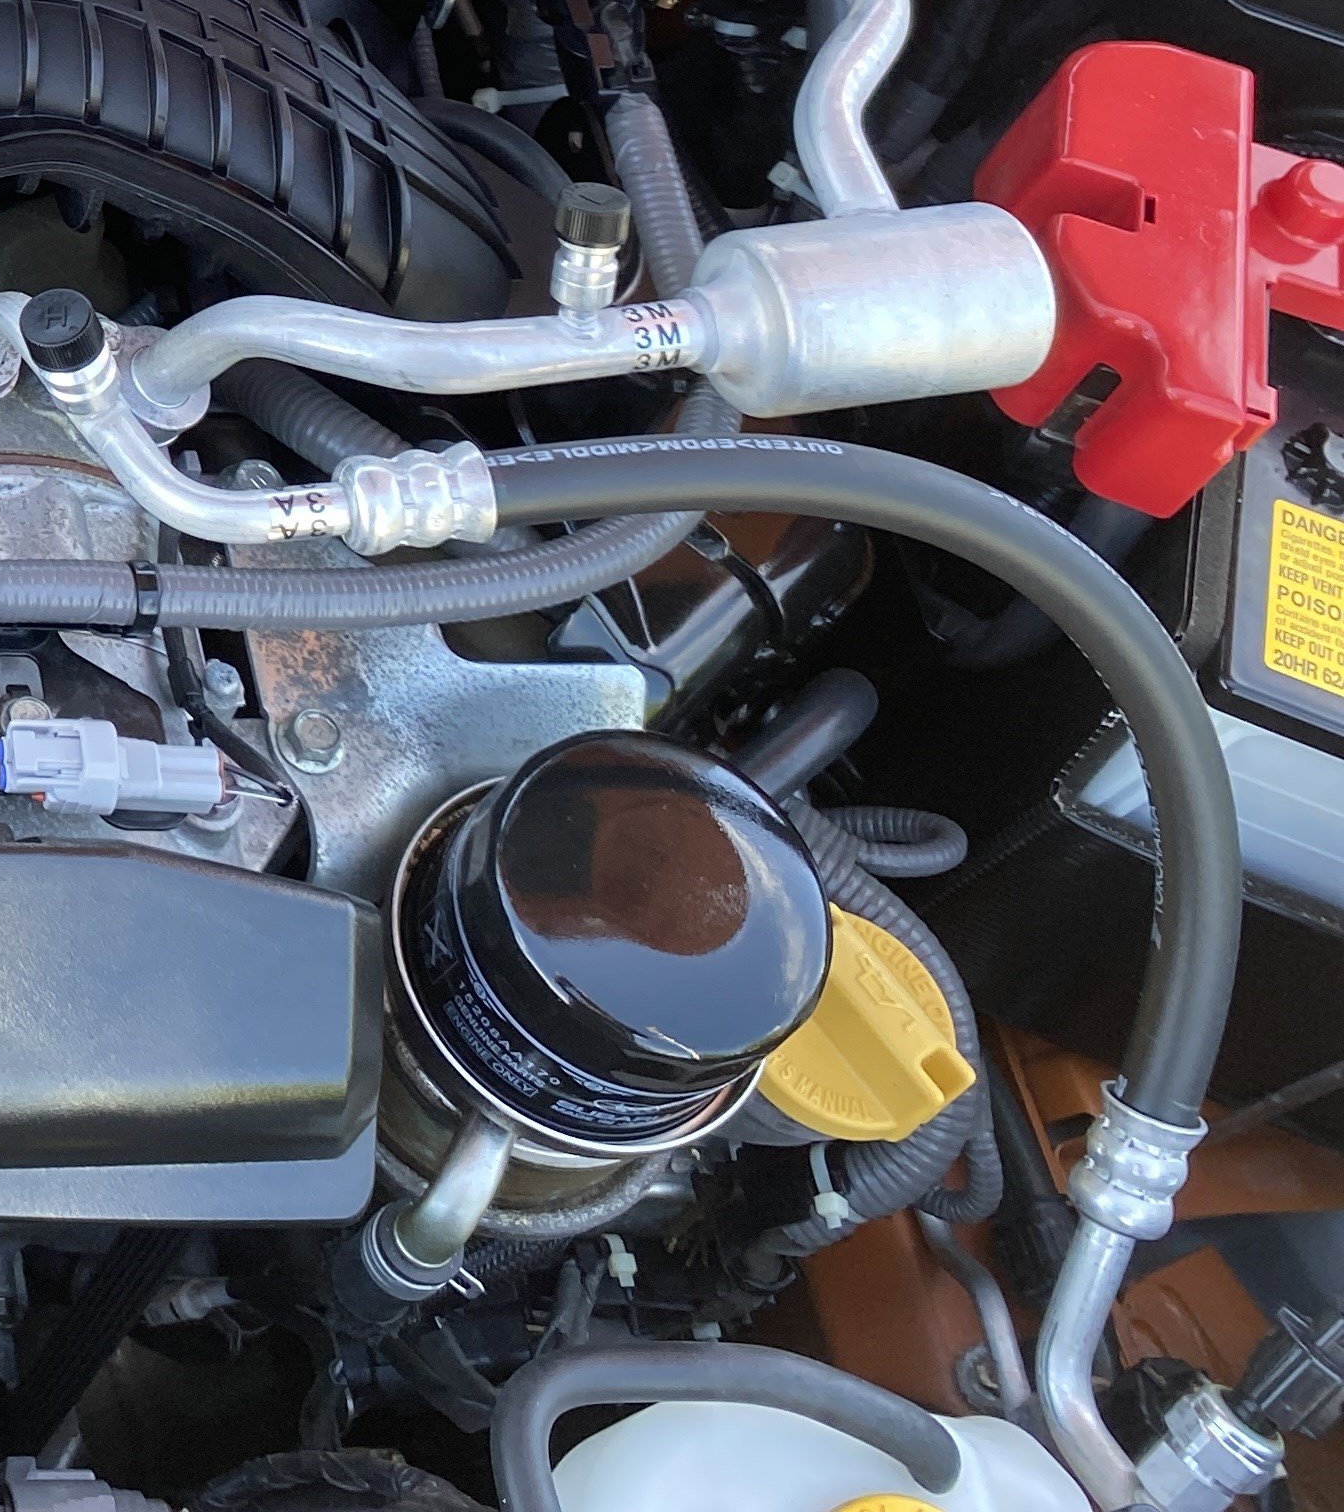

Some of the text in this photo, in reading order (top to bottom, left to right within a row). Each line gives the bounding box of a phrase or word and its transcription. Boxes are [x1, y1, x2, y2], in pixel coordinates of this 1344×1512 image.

[1279, 564, 1309, 586] KEEP
[1277, 584, 1344, 622] POISO
[1275, 626, 1306, 650] KEEP
[1308, 640, 1334, 661] OUT
[1273, 648, 1344, 690] 20HR 62
[445, 1002, 533, 1094] ENGINE ONLY
[454, 994, 546, 1088] GENUINE PARTS
[458, 980, 561, 1086] 15208AA170
